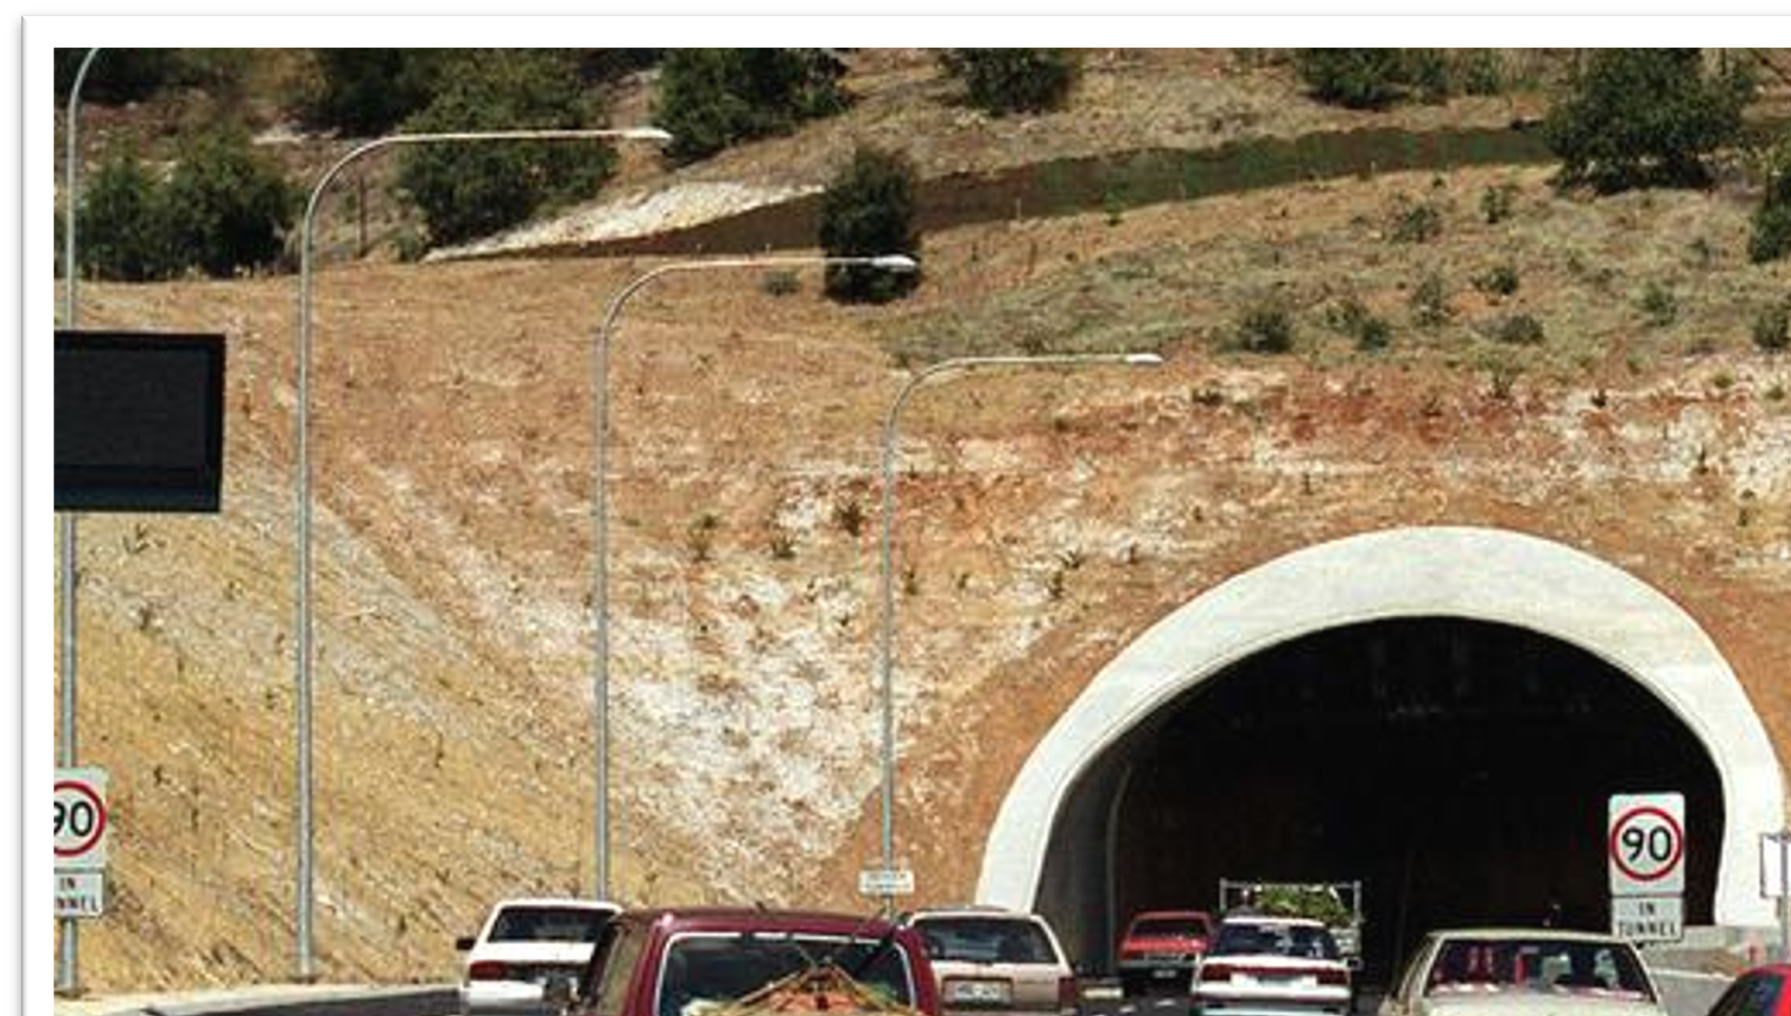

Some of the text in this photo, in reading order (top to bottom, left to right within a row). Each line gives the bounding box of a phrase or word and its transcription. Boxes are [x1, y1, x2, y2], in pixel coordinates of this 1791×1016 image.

[1622, 826, 1671, 862] 90
[1639, 902, 1655, 916] IN
[1618, 921, 1676, 937] TUNNEL
